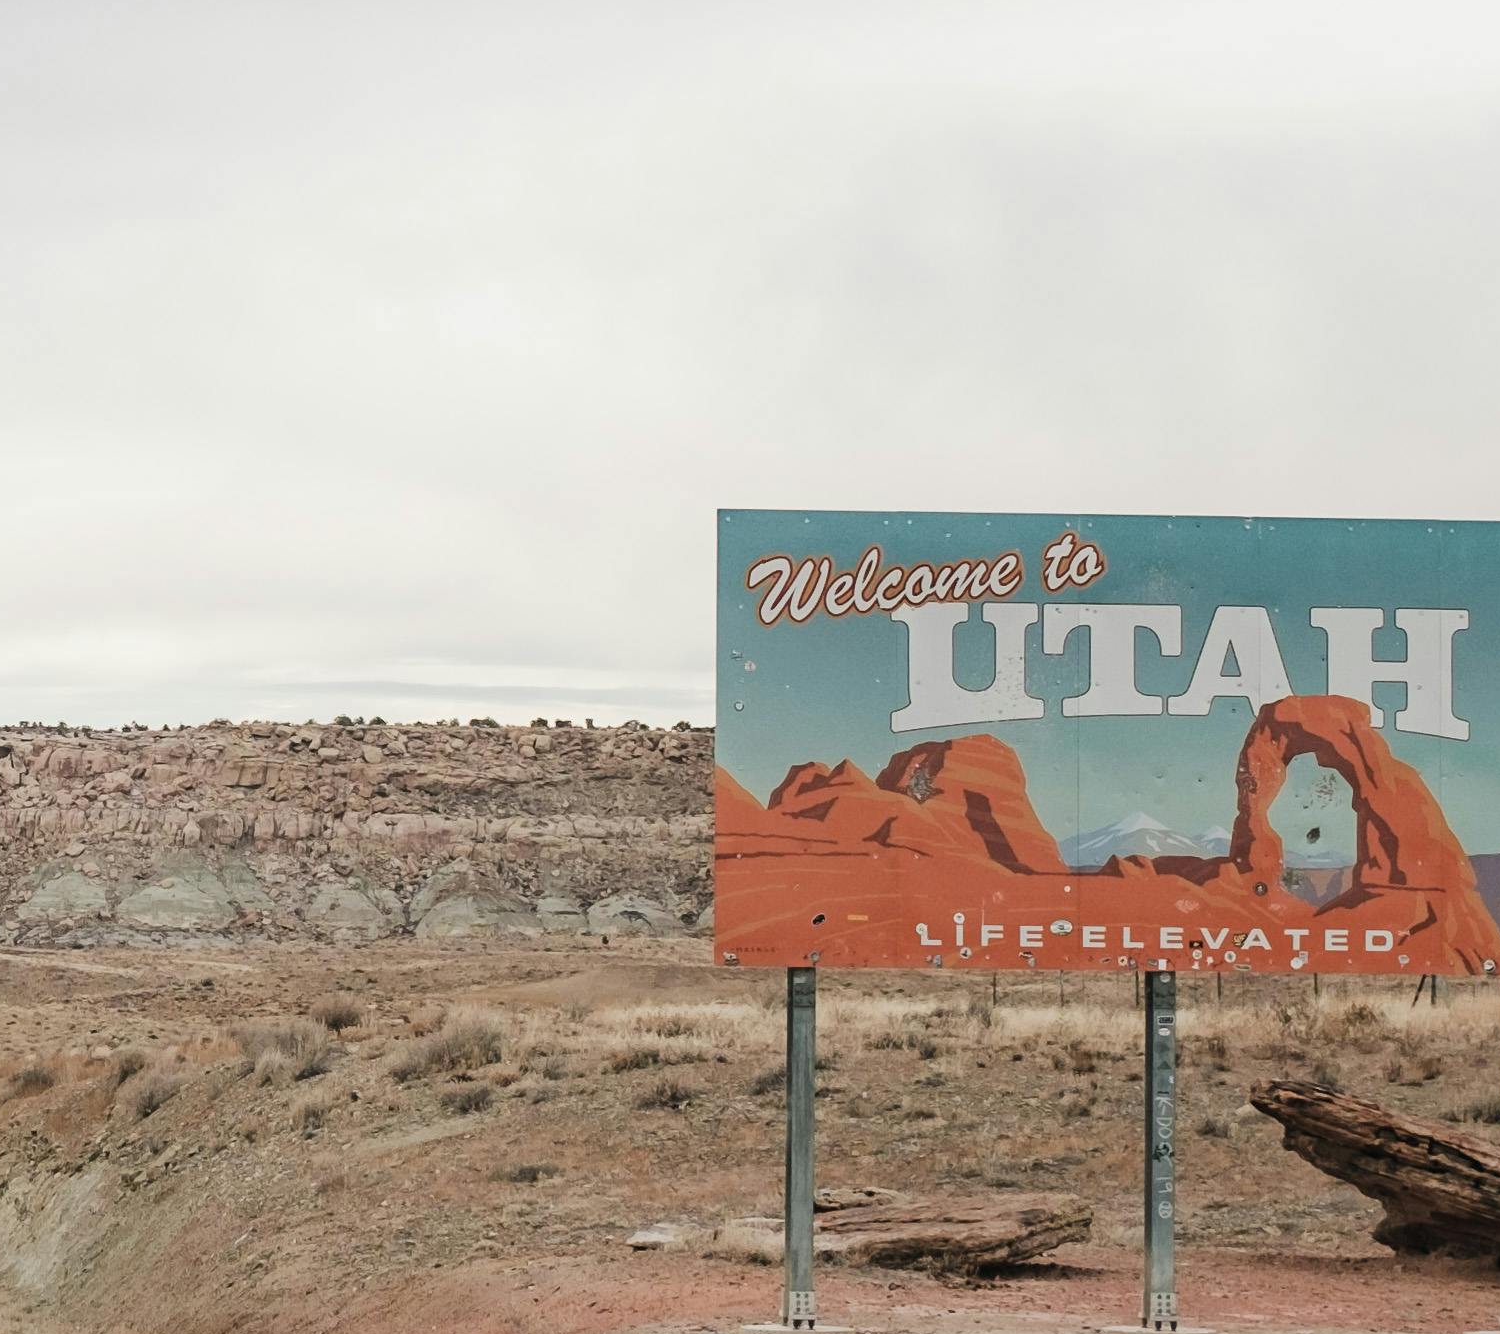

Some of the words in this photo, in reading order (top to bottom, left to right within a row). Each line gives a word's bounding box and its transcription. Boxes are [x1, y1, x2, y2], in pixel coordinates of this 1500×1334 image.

[747, 544, 1023, 626] Welcome
[1043, 532, 1105, 591] to
[890, 601, 1470, 742] UTAH
[919, 923, 1044, 948] LIFE
[1082, 925, 1395, 952] ELEVATED
